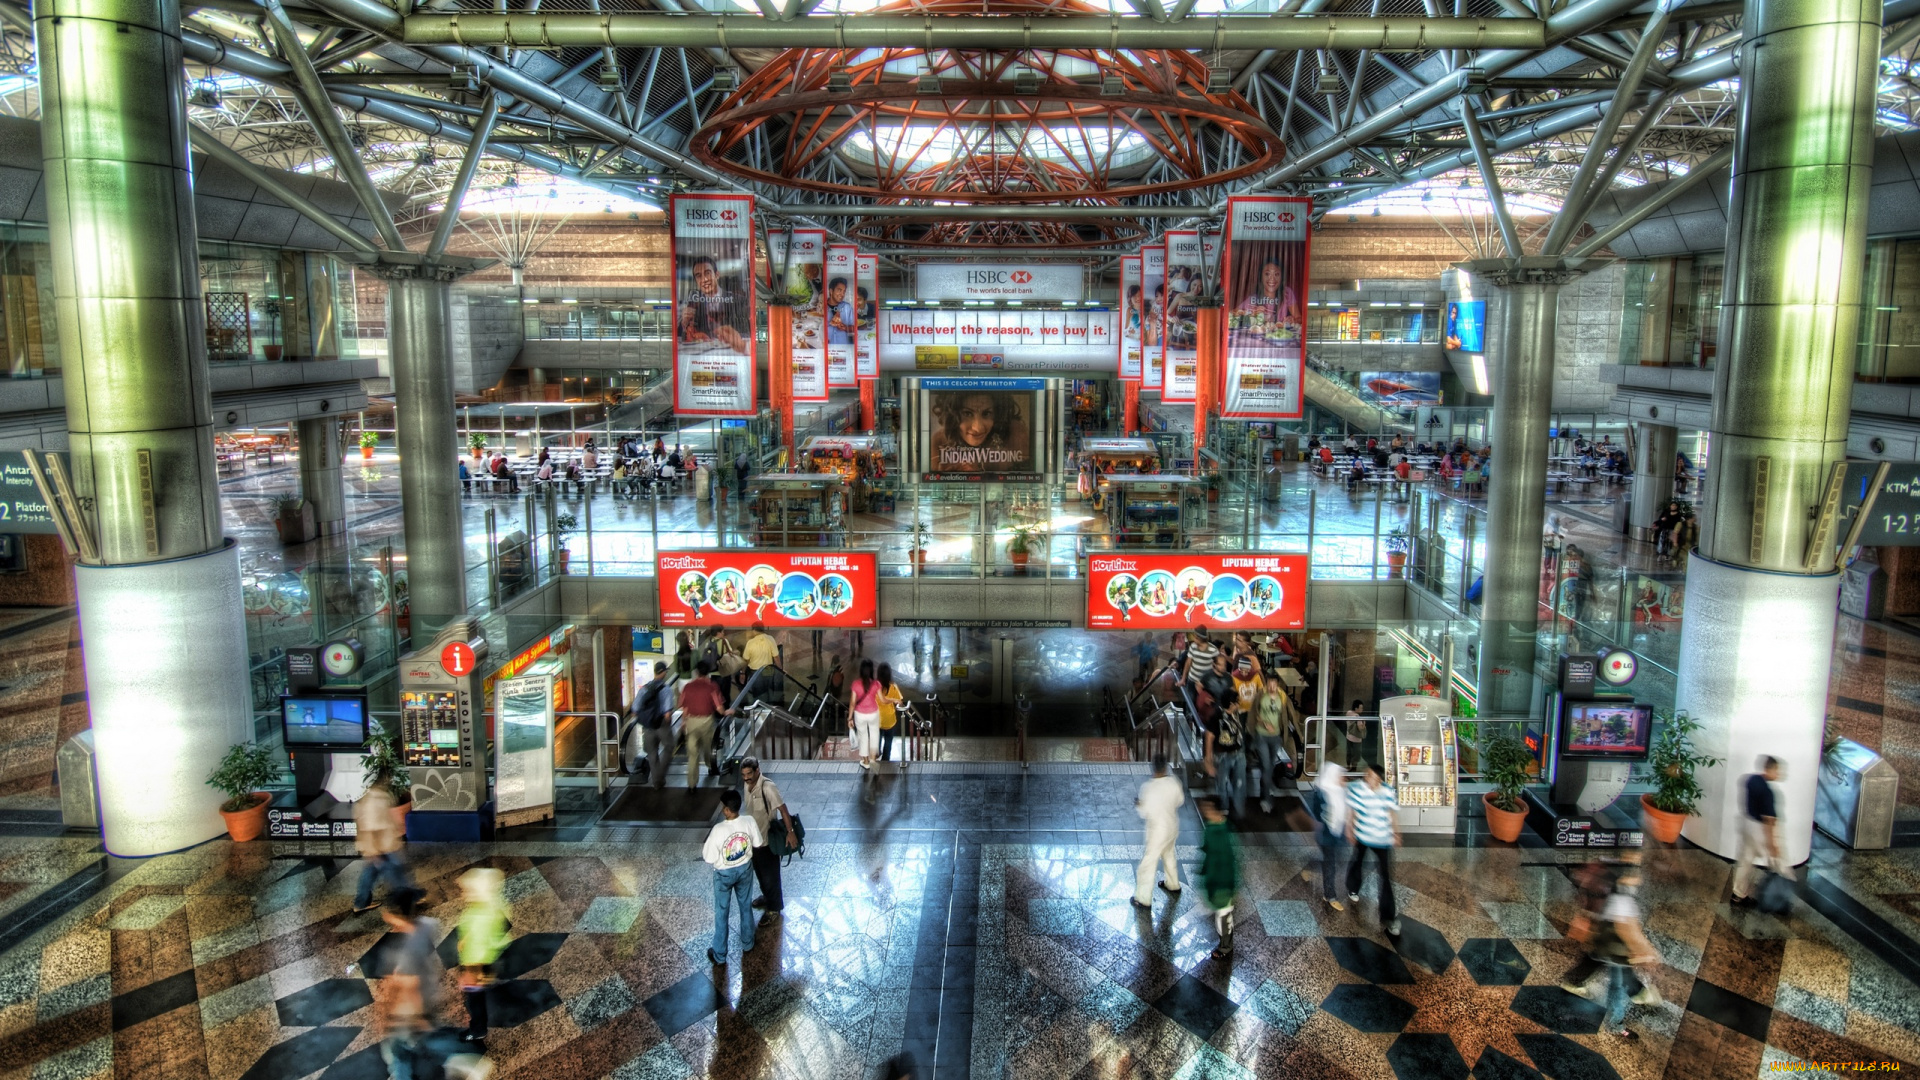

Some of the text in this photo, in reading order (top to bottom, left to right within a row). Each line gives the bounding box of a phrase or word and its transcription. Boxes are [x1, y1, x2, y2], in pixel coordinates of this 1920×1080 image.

[686, 209, 718, 221] HSBC
[1244, 212, 1275, 223] HSBC
[1176, 243, 1199, 252] HSBC
[967, 270, 1007, 284] HSBC
[692, 293, 734, 304] Gourmet
[1250, 296, 1279, 305] Buffet
[892, 324, 1107, 337] Whatever the reason, we buy it.
[1007, 361, 1090, 370] SmartPrivileges
[692, 388, 738, 396] SmartPrivileges
[1239, 391, 1286, 399] SmartPrivileges
[6, 477, 34, 486] Intercity
[1886, 482, 1909, 493] KTM
[1883, 514, 1907, 533] 1-2
[791, 556, 822, 565] LIPUTAN
[823, 556, 848, 566] HEBAT
[1222, 558, 1254, 567] LIPUTAN
[1255, 558, 1280, 567] HEBAT
[1009, 620, 1023, 628] Jalan
[524, 678, 546, 686] Sentral
[522, 685, 545, 693] Lumpur
[461, 691, 472, 768] DIRECTORY
